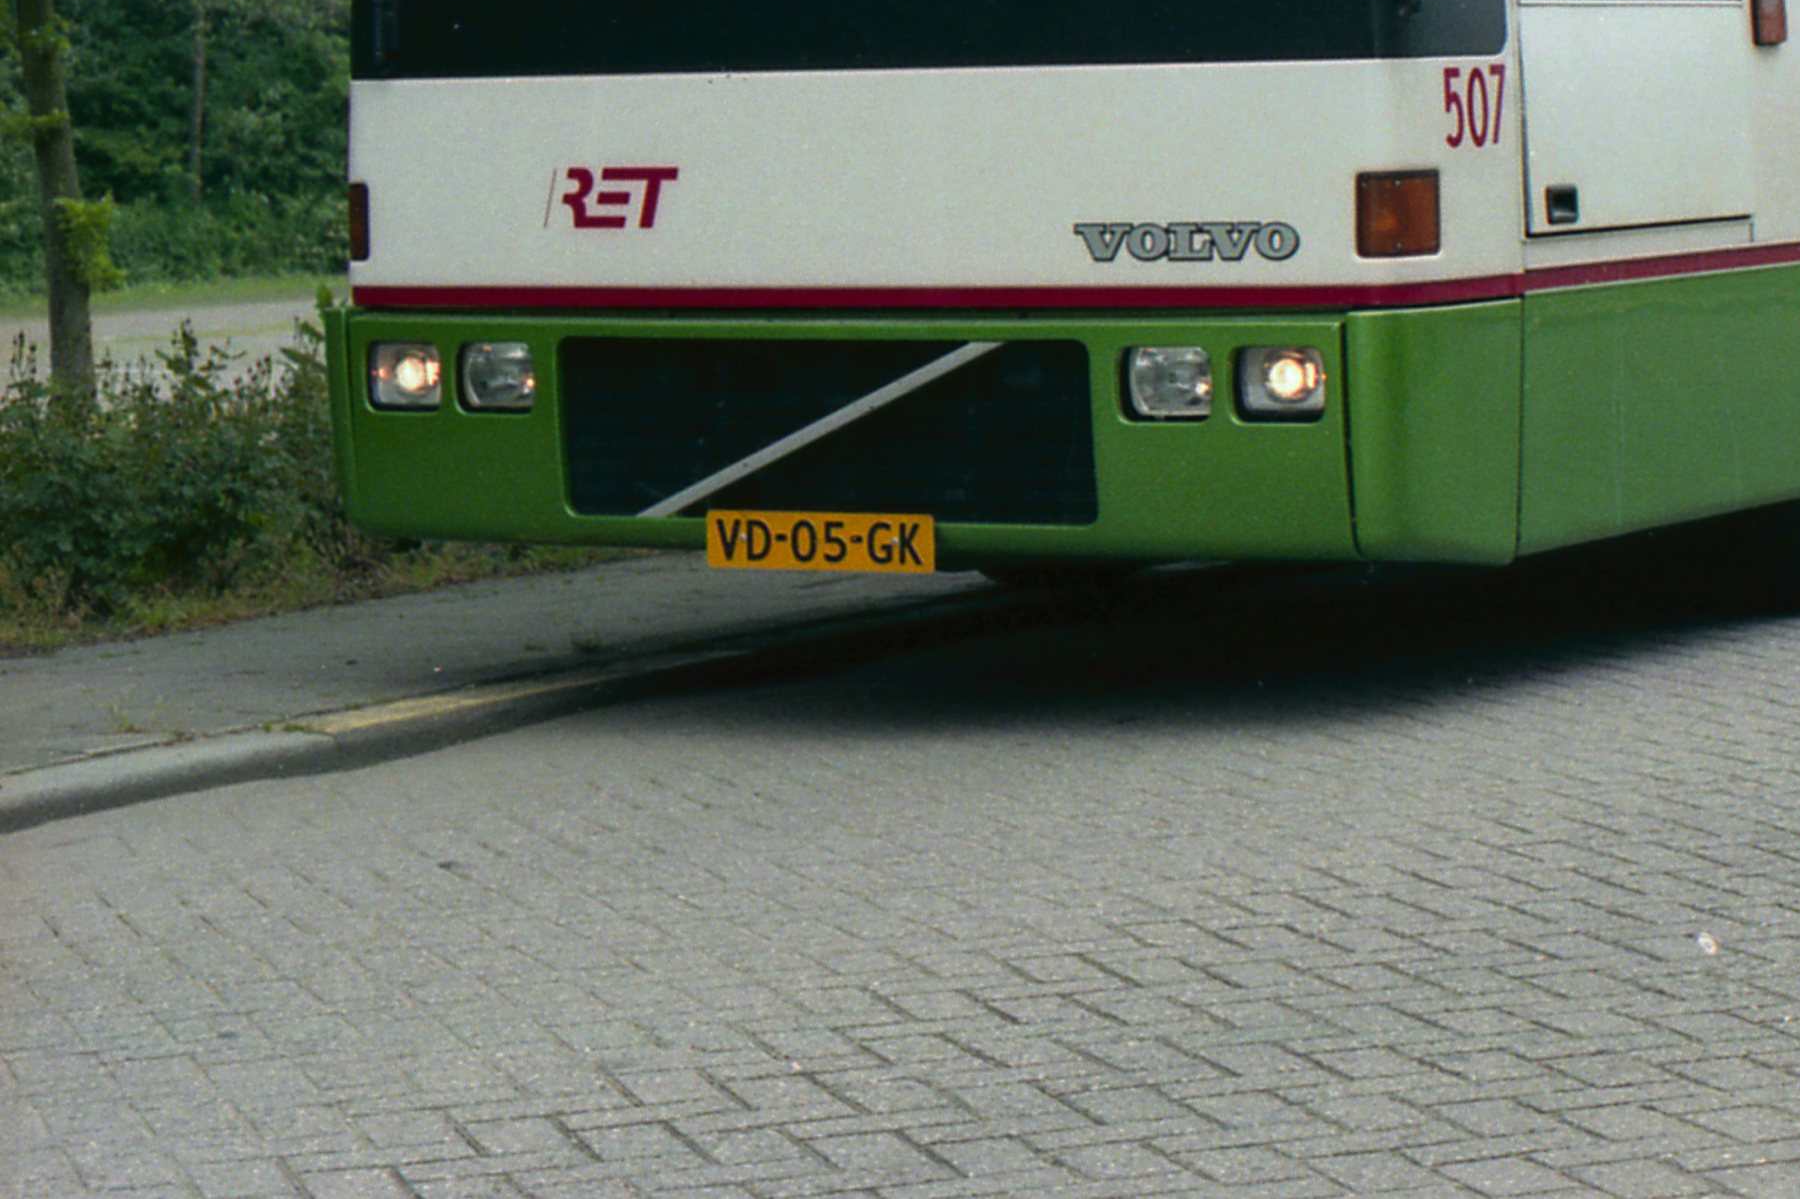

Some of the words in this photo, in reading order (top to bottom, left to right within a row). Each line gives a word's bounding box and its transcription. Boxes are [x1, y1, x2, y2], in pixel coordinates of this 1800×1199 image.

[1443, 64, 1505, 148] 507
[562, 167, 679, 229] RET
[1074, 221, 1300, 263] VOLVO
[716, 518, 923, 566] VD-05-GK
